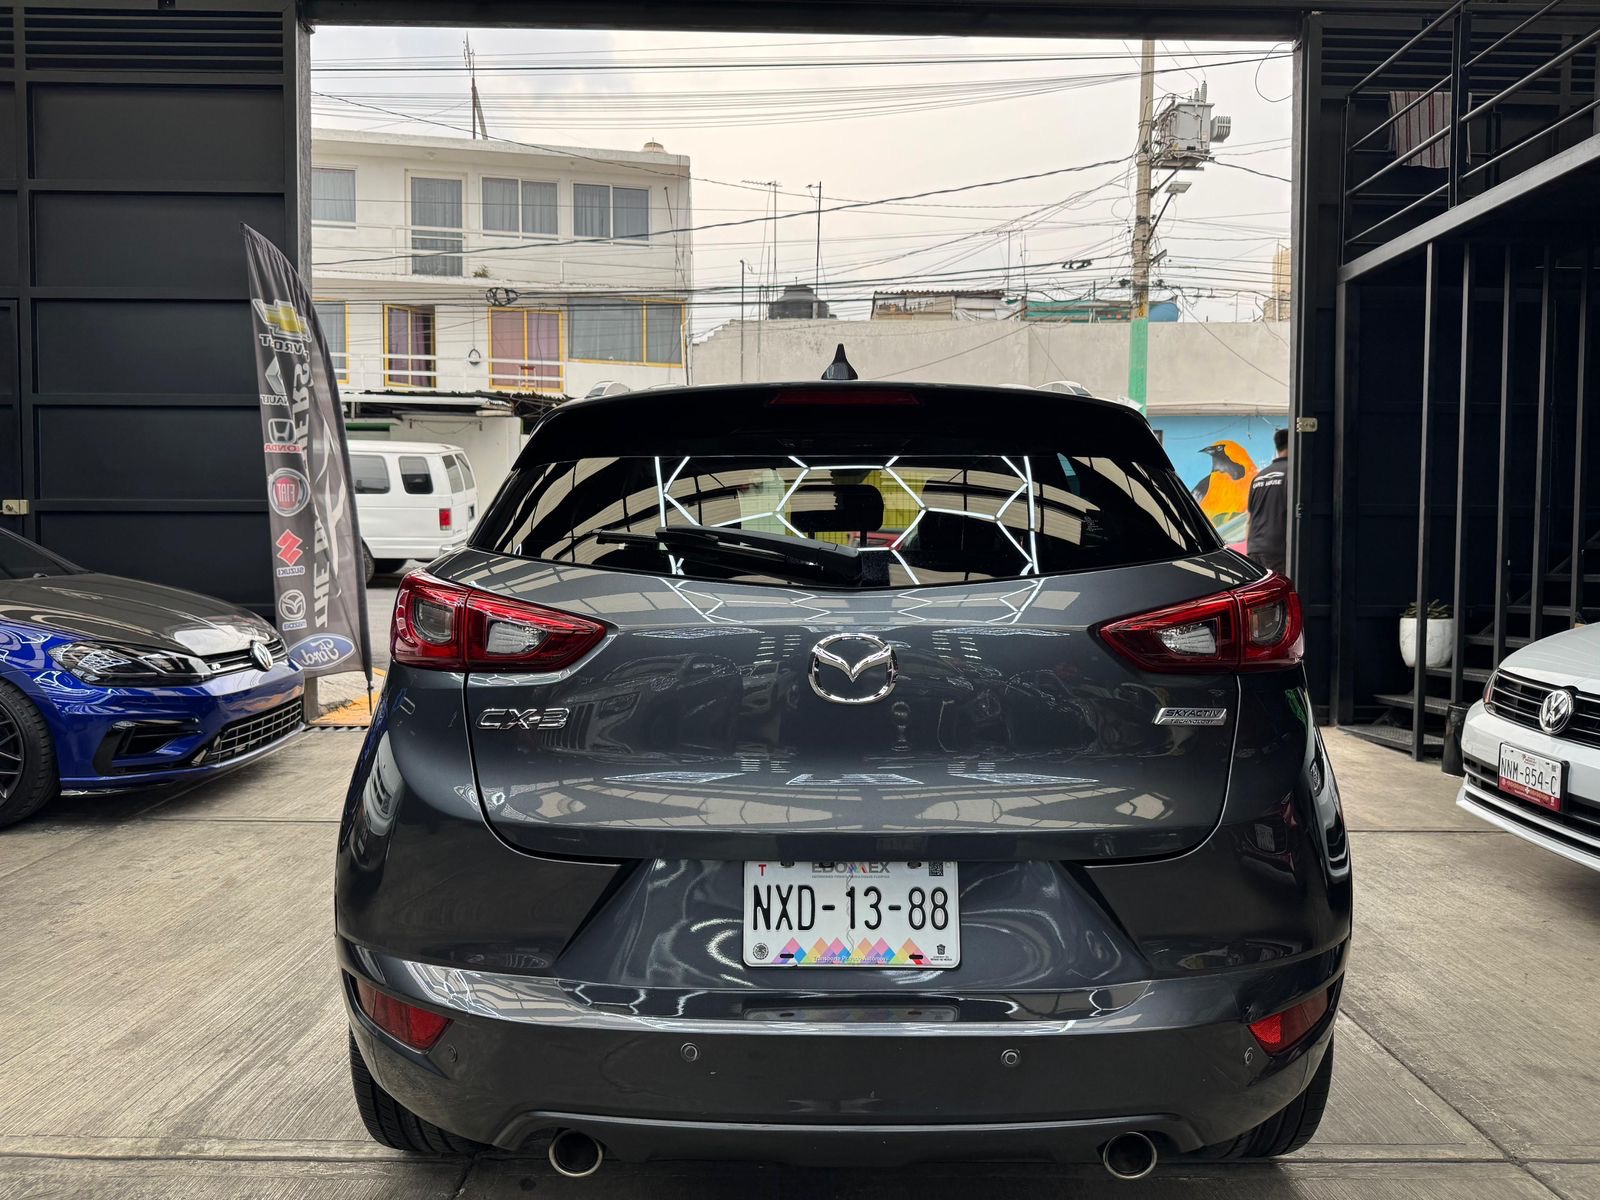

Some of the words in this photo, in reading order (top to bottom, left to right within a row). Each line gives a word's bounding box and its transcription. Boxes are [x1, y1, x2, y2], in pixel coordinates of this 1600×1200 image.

[475, 707, 570, 730] CX-3
[1165, 709, 1222, 717] SKYACTIV
[1500, 757, 1558, 795] NNM-854-C
[758, 864, 767, 877] T
[752, 884, 949, 931] NXD-13-88
